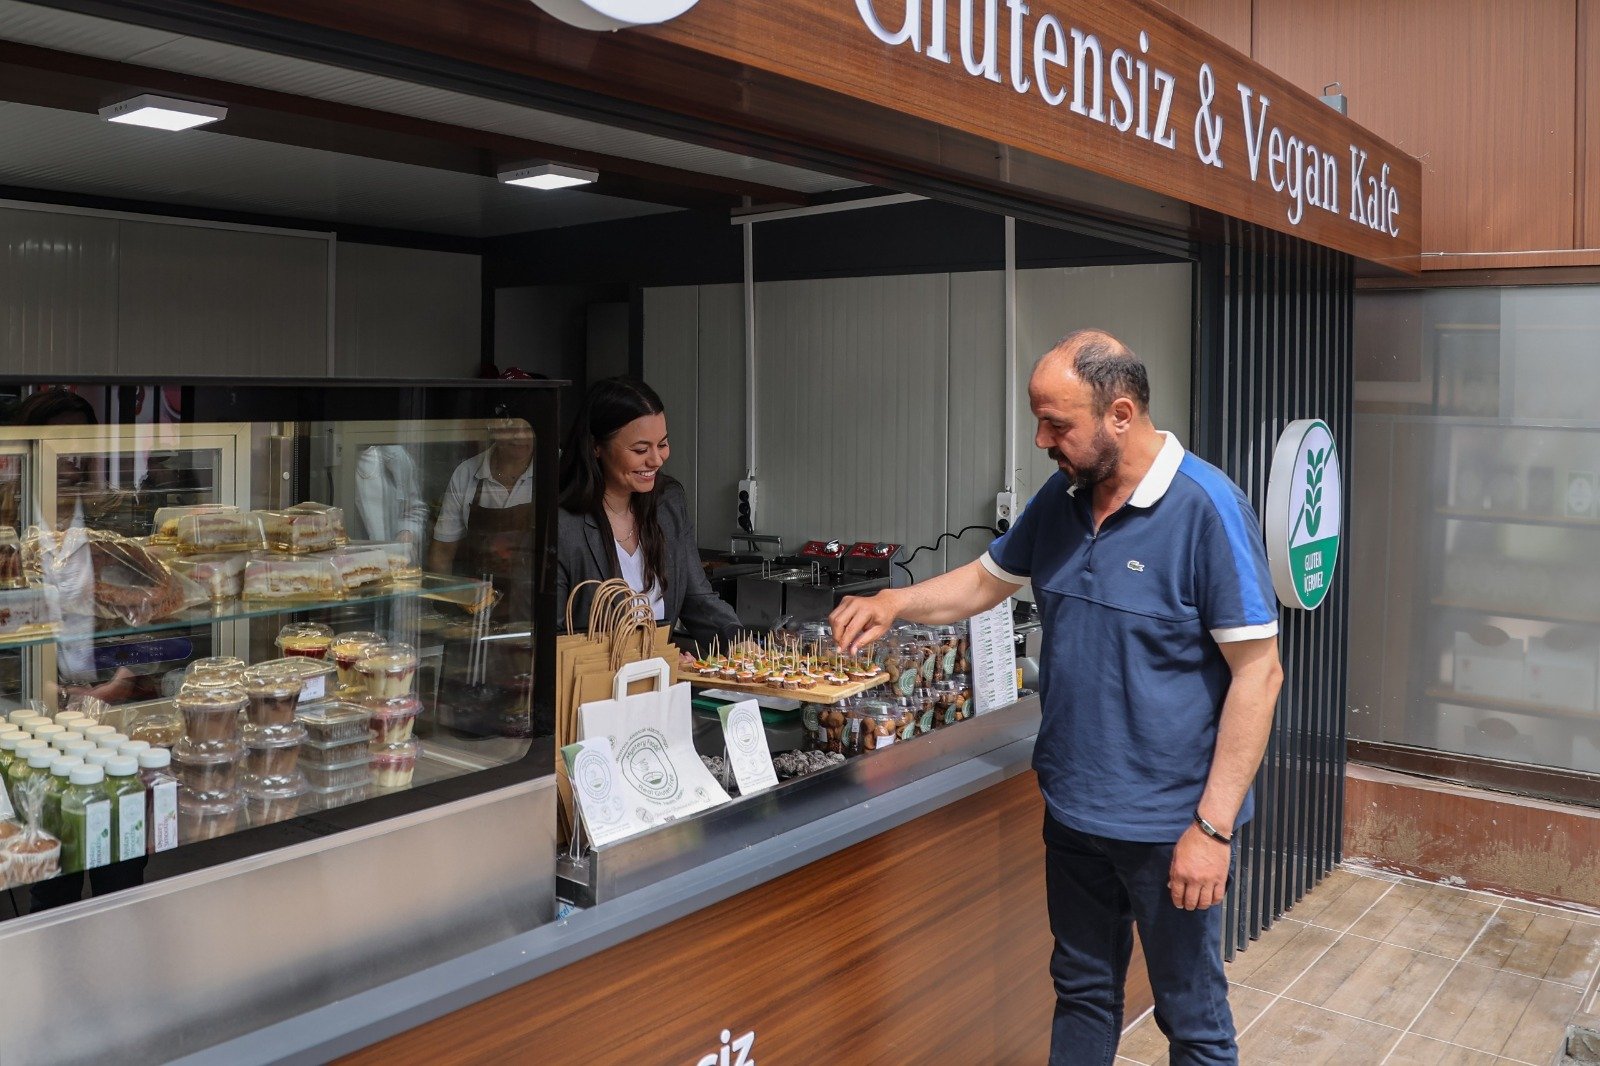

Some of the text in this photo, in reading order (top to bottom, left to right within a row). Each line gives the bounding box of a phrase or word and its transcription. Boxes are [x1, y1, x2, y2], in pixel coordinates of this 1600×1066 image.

[855, 0, 1399, 238] utensiz & Vegan Kafe
[1304, 551, 1322, 570] GLUTEN
